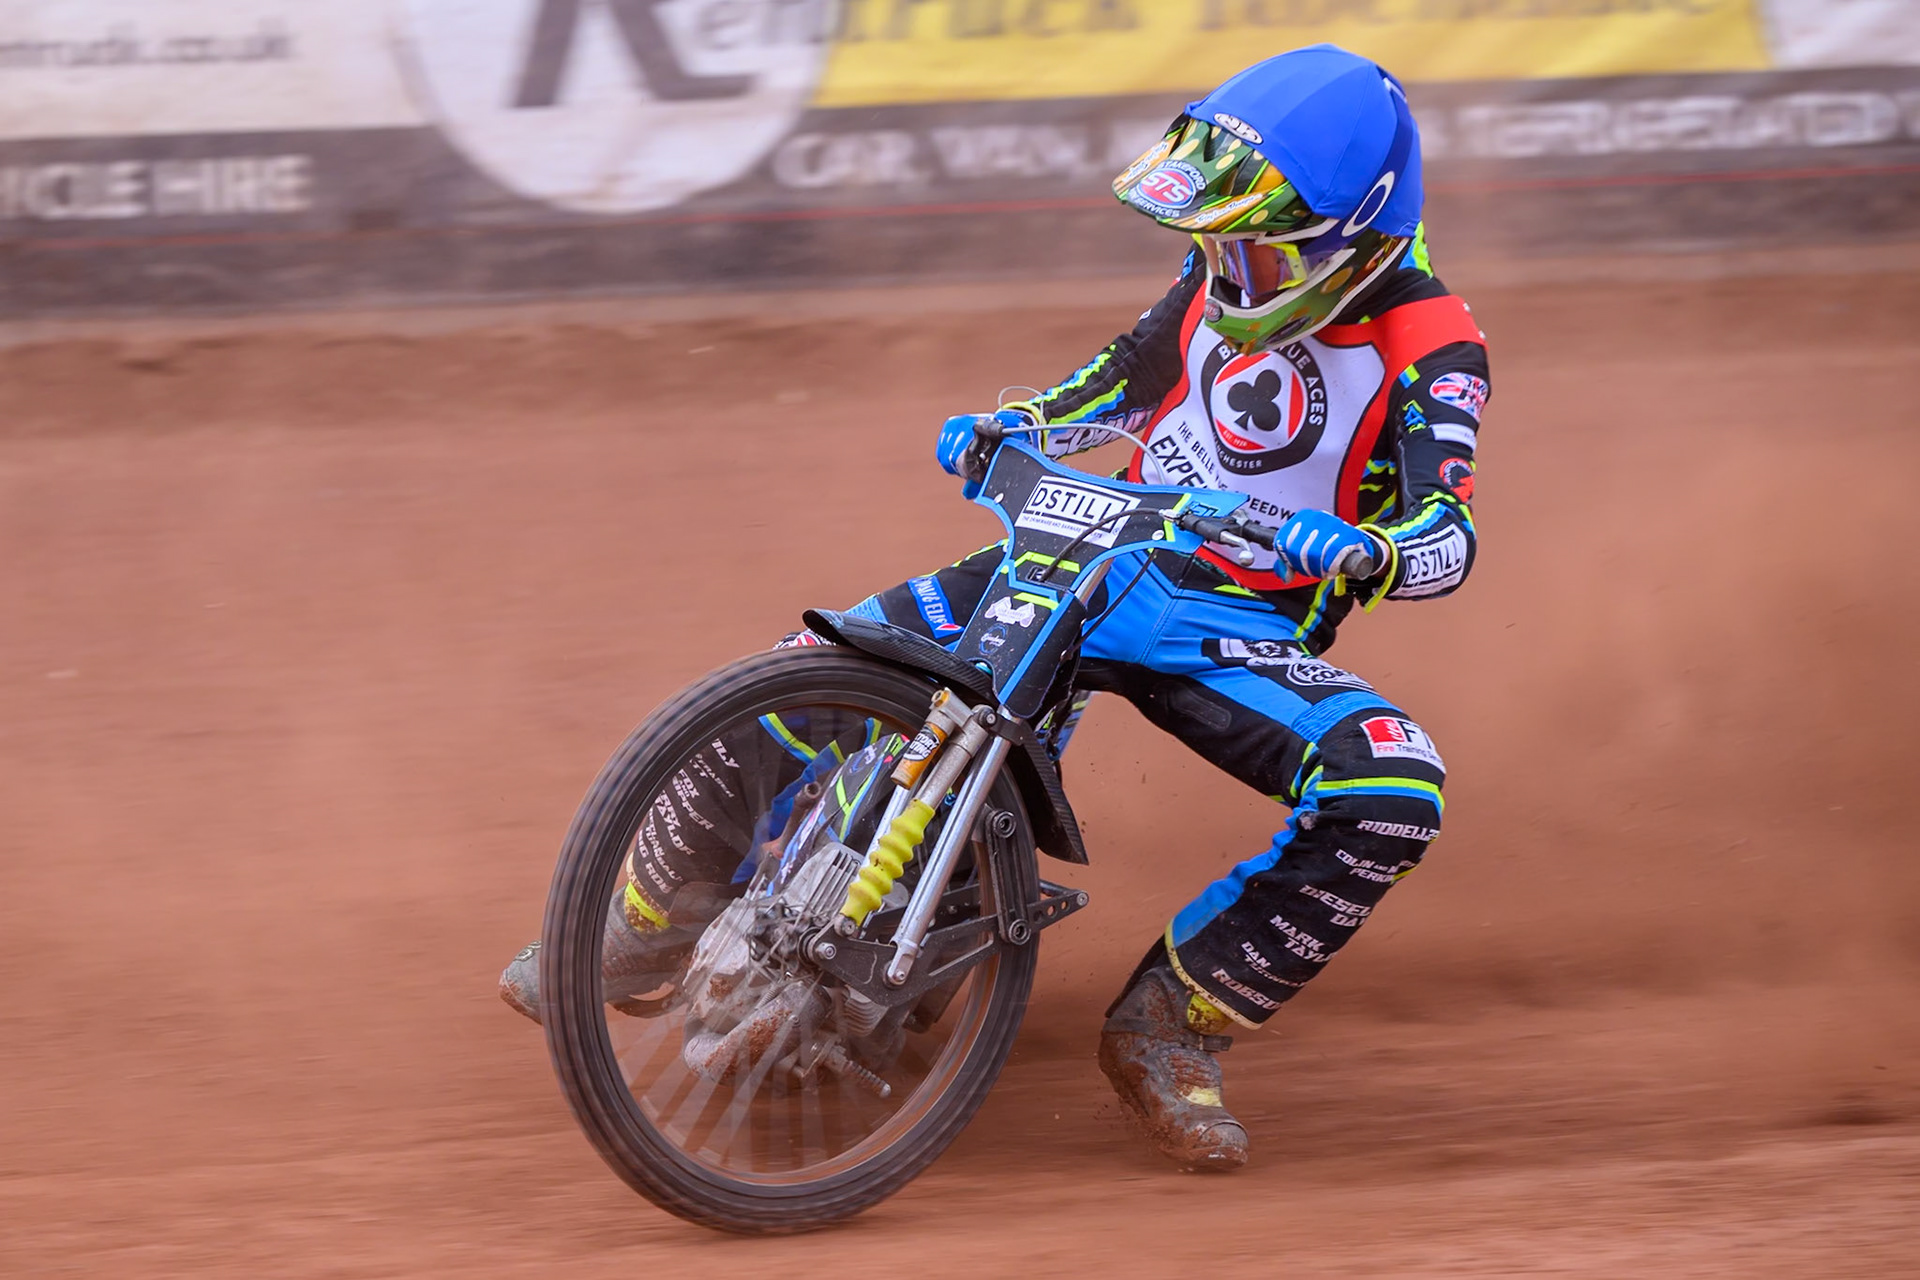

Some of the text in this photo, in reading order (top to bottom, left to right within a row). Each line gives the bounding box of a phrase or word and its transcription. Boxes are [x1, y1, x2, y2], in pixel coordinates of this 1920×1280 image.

[1141, 171, 1193, 203] STS
[1305, 376, 1325, 426] ACES
[1150, 434, 1207, 488] EXPE
[1178, 421, 1193, 443] THE
[1191, 440, 1215, 475] BELLE
[1407, 540, 1461, 579] DSTILL
[711, 737, 740, 768] ILY
[1376, 745, 1395, 753] Fire
[678, 769, 700, 798] FOX
[1335, 848, 1375, 869] COLIN
[1269, 914, 1326, 951] MARK
[1241, 941, 1272, 968] DAN
